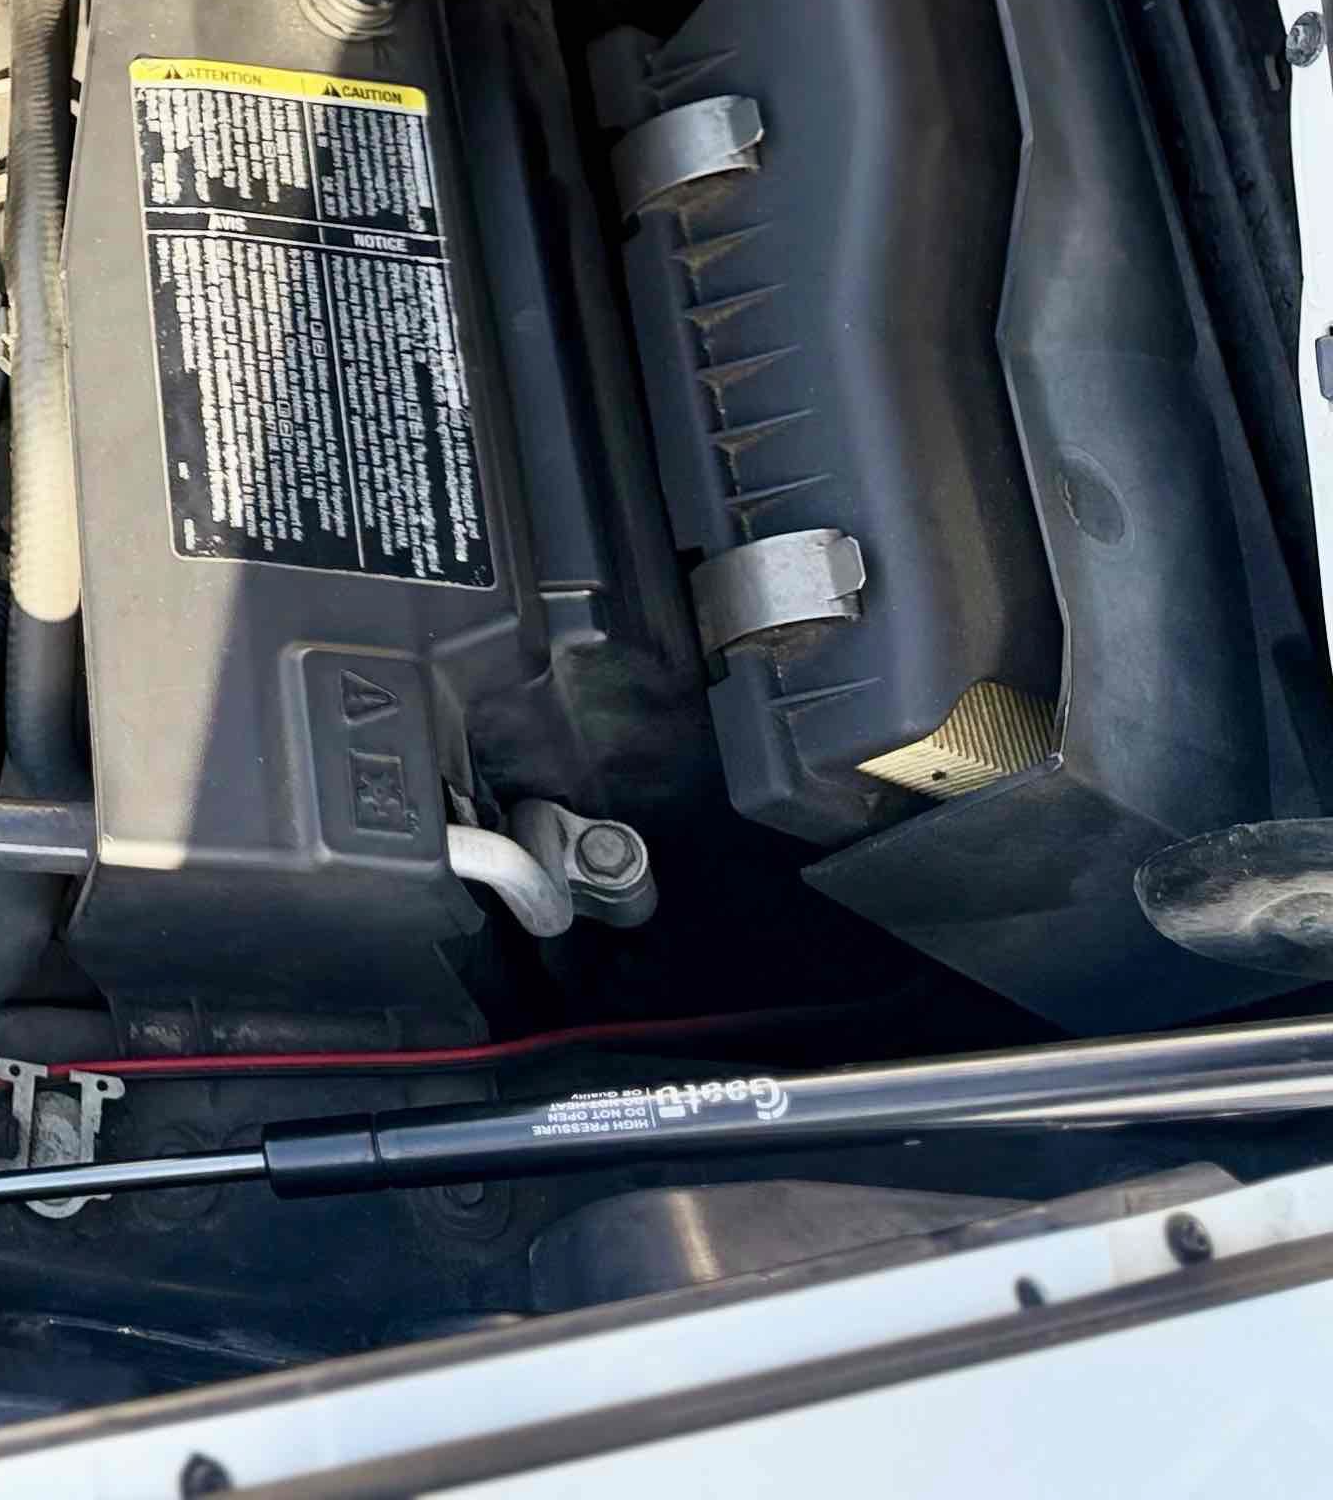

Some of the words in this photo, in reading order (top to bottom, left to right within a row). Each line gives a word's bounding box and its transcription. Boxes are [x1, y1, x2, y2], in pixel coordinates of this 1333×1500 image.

[186, 69, 262, 87] ATTENTION
[341, 84, 403, 105] CAUTION
[208, 213, 247, 232] AVIS
[353, 233, 408, 252] NOTICE
[570, 1090, 619, 1101] Quality
[547, 1110, 588, 1124] OPEN
[591, 1108, 622, 1120] NOT
[625, 1106, 647, 1118] DO
[531, 1121, 610, 1136] PRESSURE
[612, 1118, 649, 1130] HIGH
